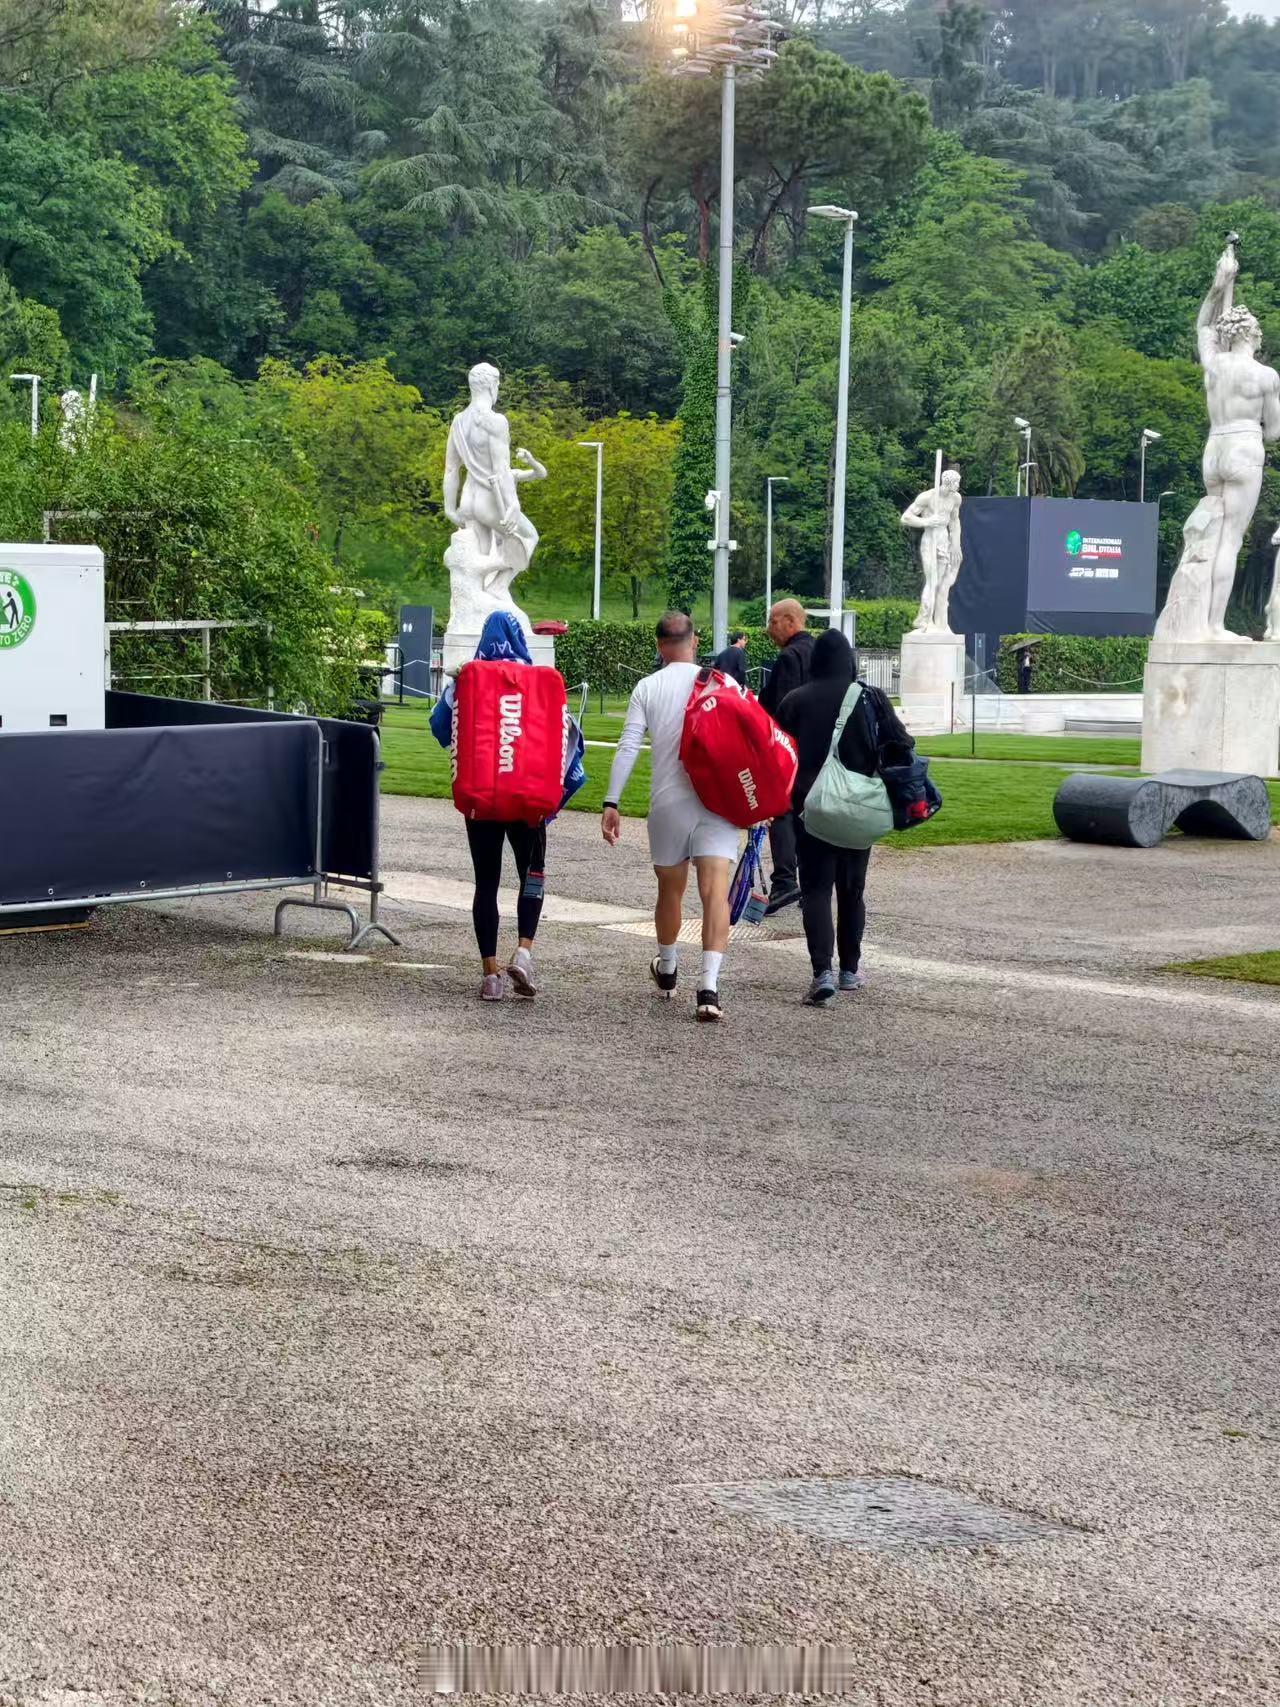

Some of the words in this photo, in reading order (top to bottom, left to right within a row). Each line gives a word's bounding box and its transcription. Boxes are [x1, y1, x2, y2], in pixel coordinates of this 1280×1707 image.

[1082, 544, 1099, 553] BNL
[12, 615, 32, 642] ZERO
[498, 693, 523, 774] Wilson
[738, 767, 759, 811] Wilson
